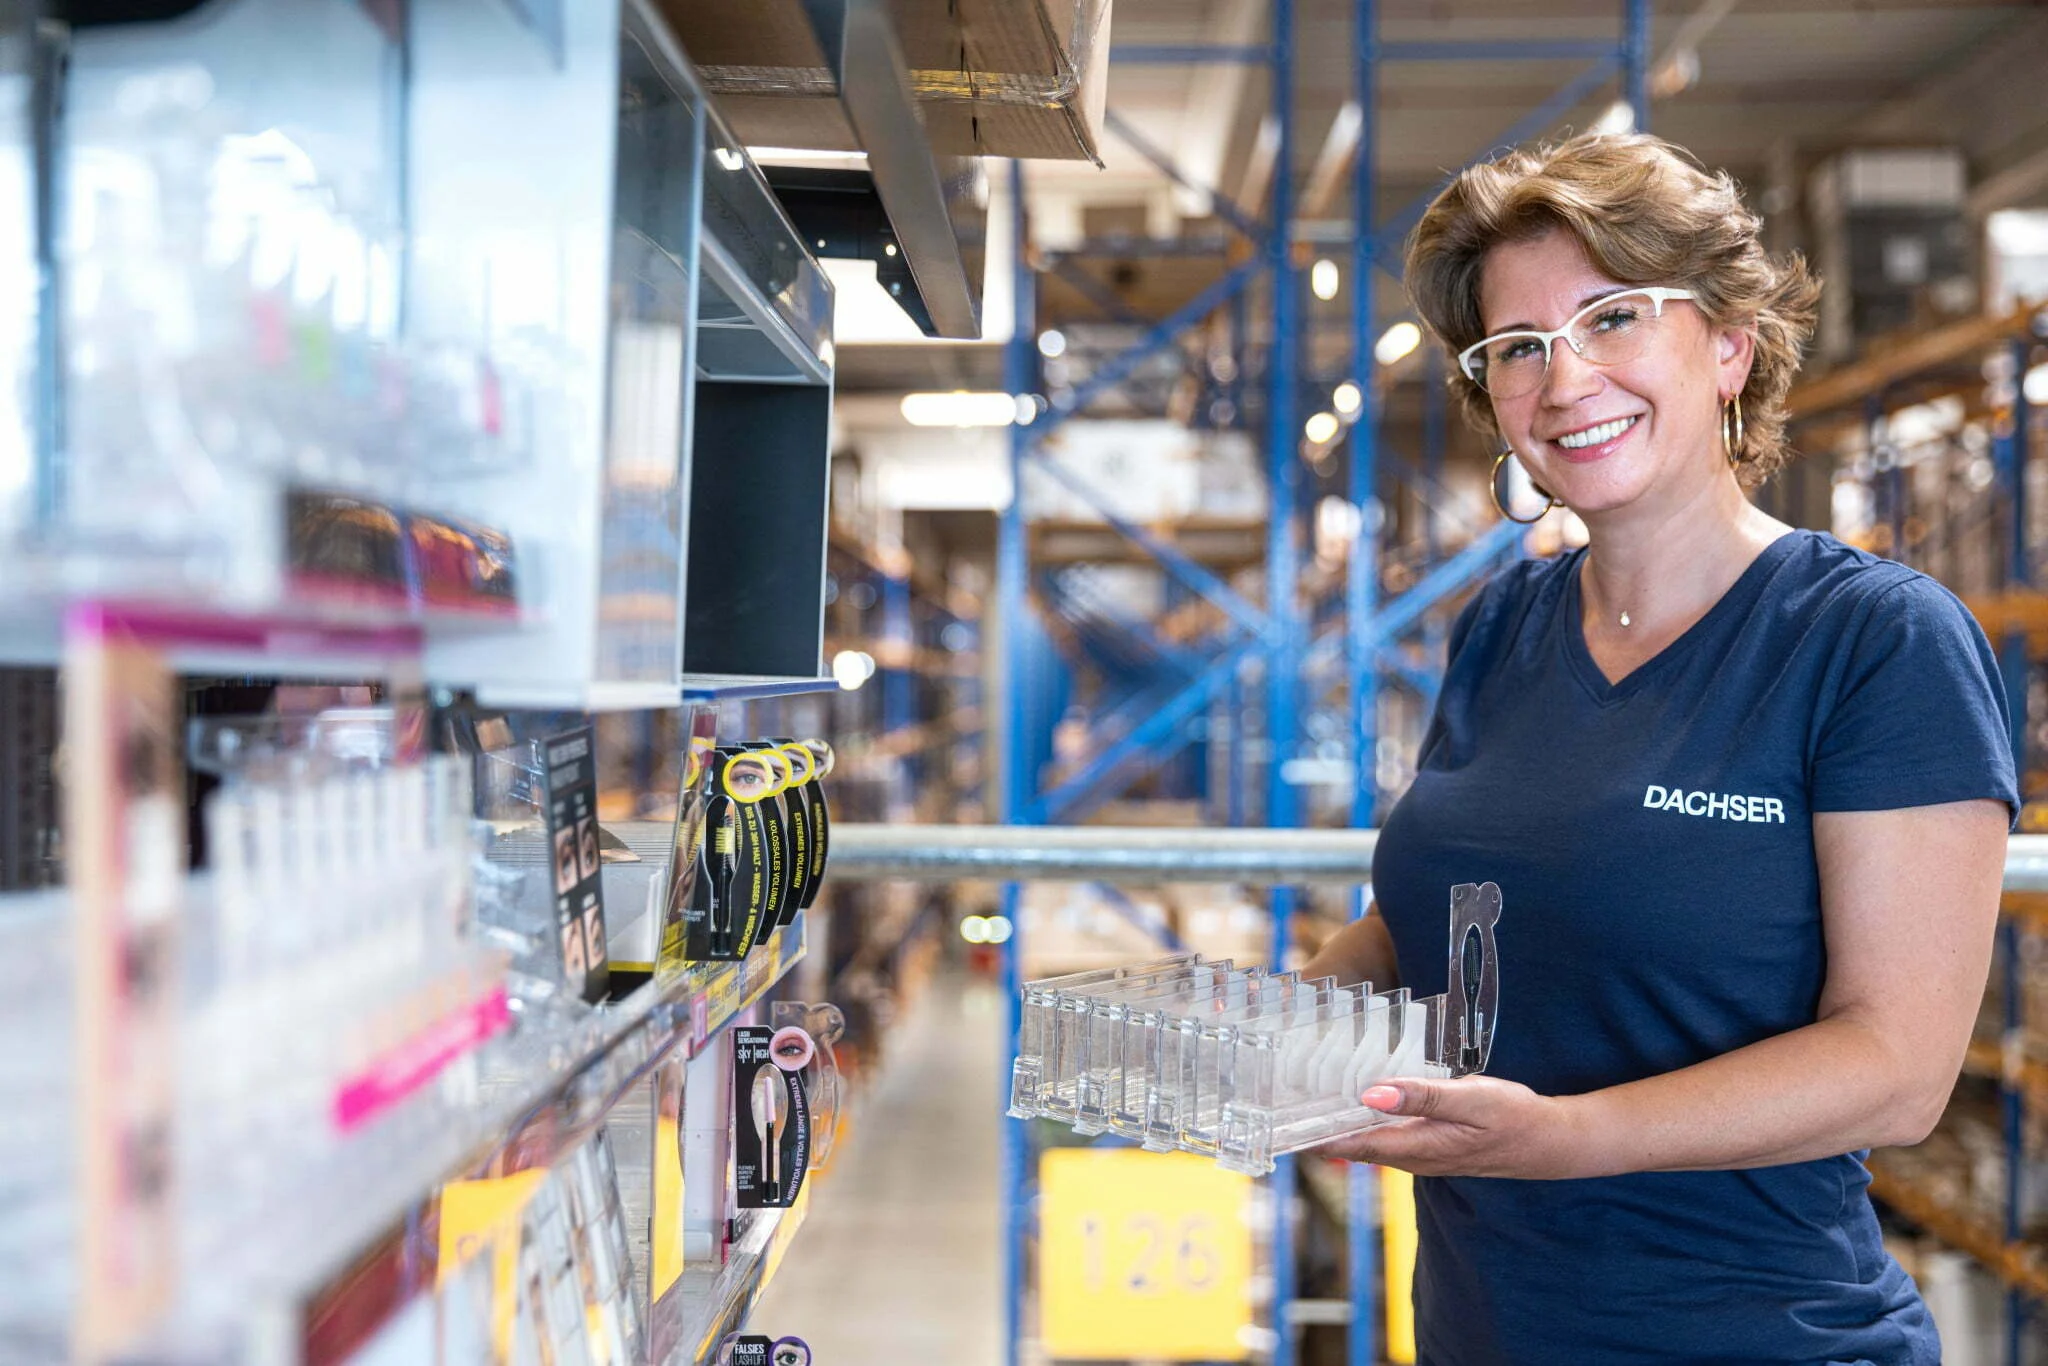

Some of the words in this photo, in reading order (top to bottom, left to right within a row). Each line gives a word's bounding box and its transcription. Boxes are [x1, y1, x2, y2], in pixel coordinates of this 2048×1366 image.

[1643, 785, 1785, 823] DACHSER
[749, 820, 757, 830] ZU
[794, 812, 805, 852] EXTREMES
[752, 846, 761, 866] HALT
[769, 820, 781, 871] KOLOSSALES
[793, 853, 805, 889] VOLUMEN
[768, 872, 780, 911] VOLUMEN
[738, 1045, 751, 1064] SKY
[753, 1045, 769, 1064] HIGH
[790, 1077, 803, 1109] EXTREME
[795, 1140, 805, 1167] VOLLES
[787, 1168, 801, 1201] VOLUMEN
[735, 1344, 765, 1354] FALSIES
